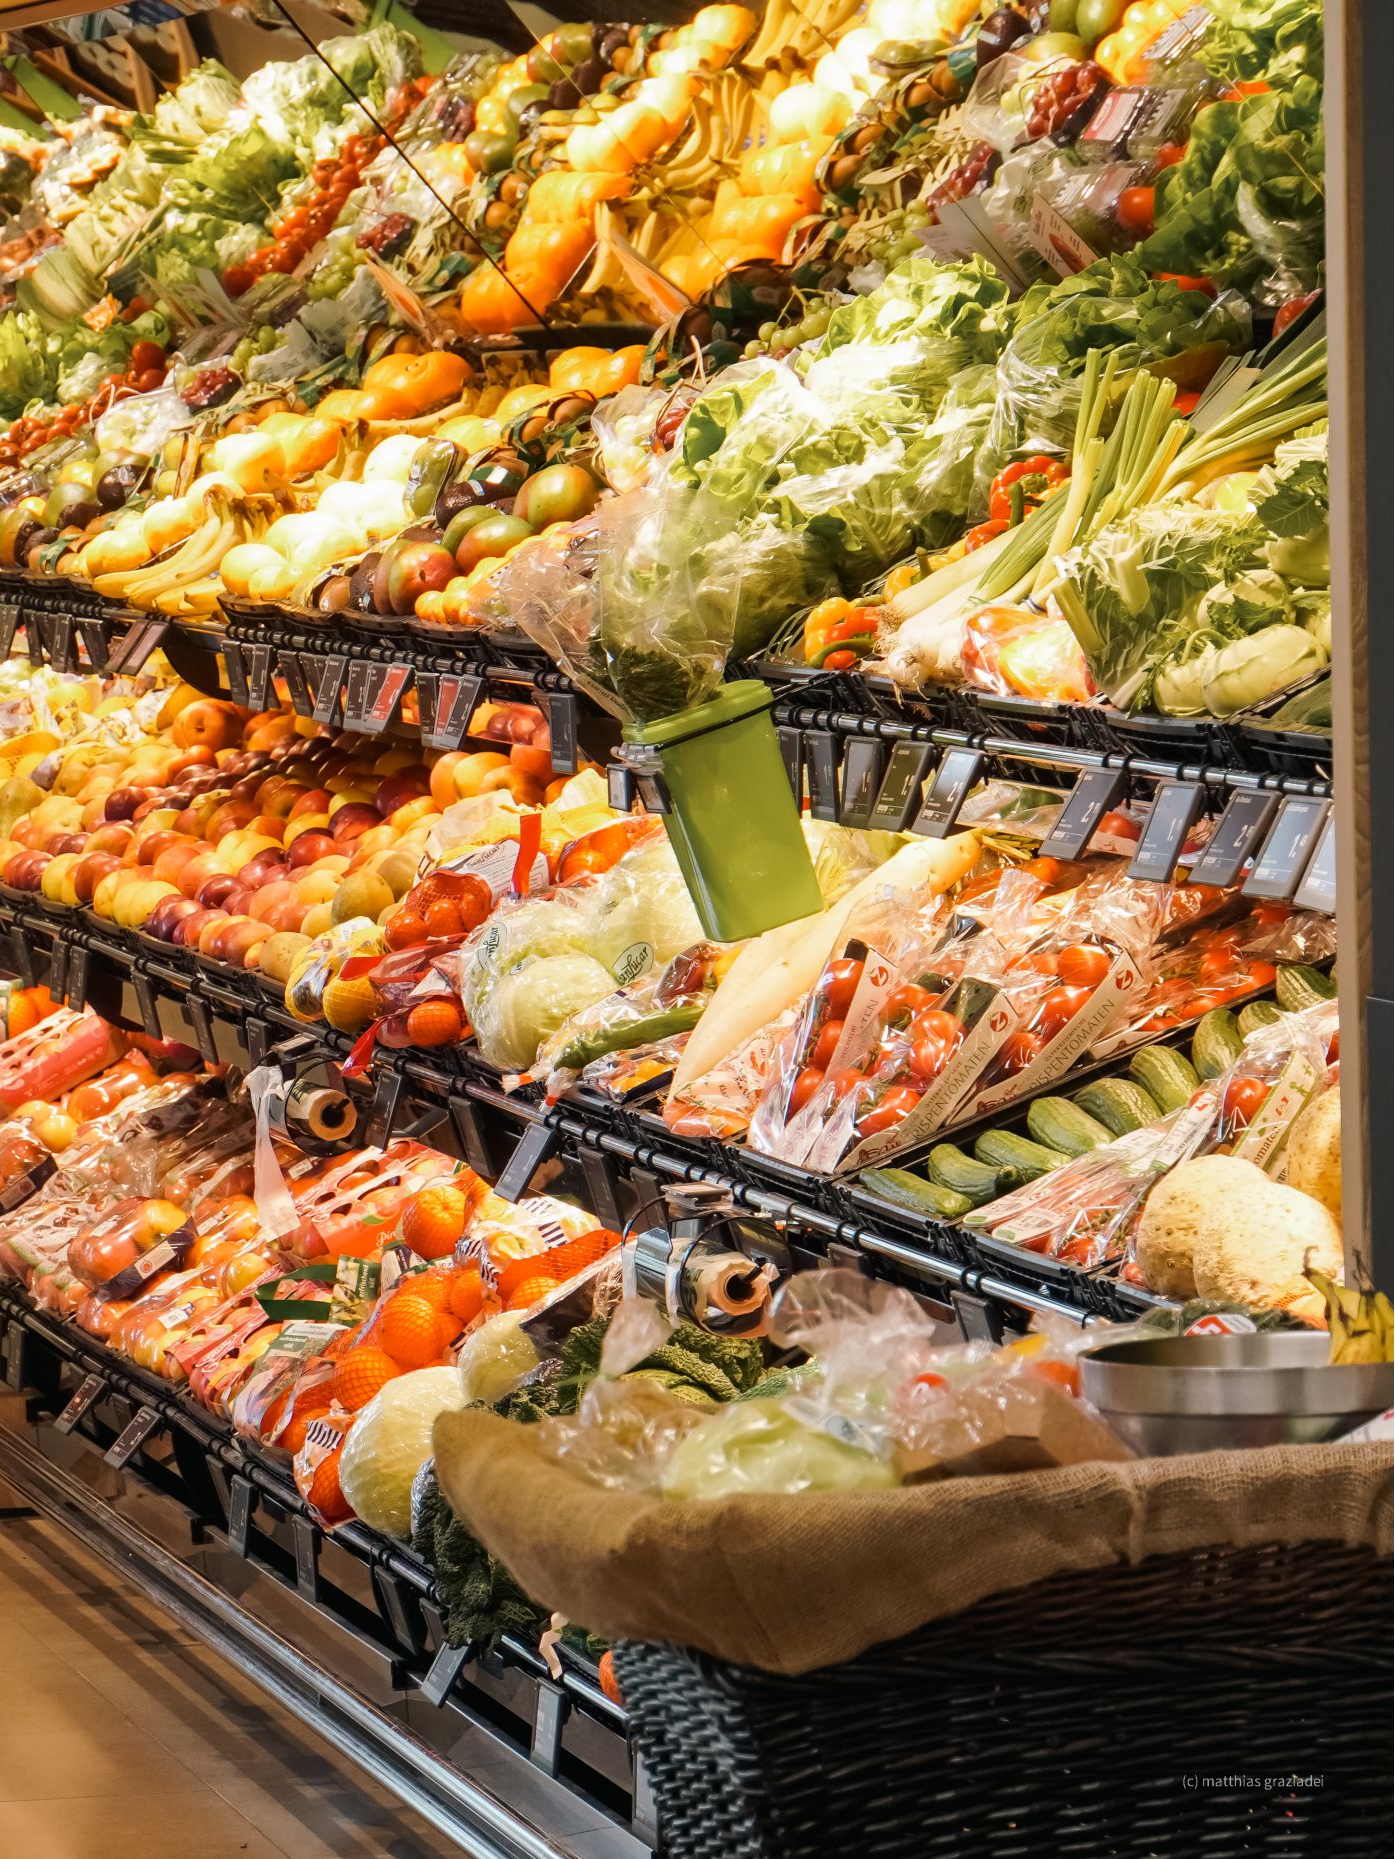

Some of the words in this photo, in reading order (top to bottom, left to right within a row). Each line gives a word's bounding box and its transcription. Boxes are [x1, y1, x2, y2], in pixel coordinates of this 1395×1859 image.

[910, 1041, 992, 1141] RISPENTOMATEN
[1254, 1126, 1282, 1165] omaten
[376, 1230, 396, 1247] Pin
[358, 1264, 370, 1298] erfrischend
